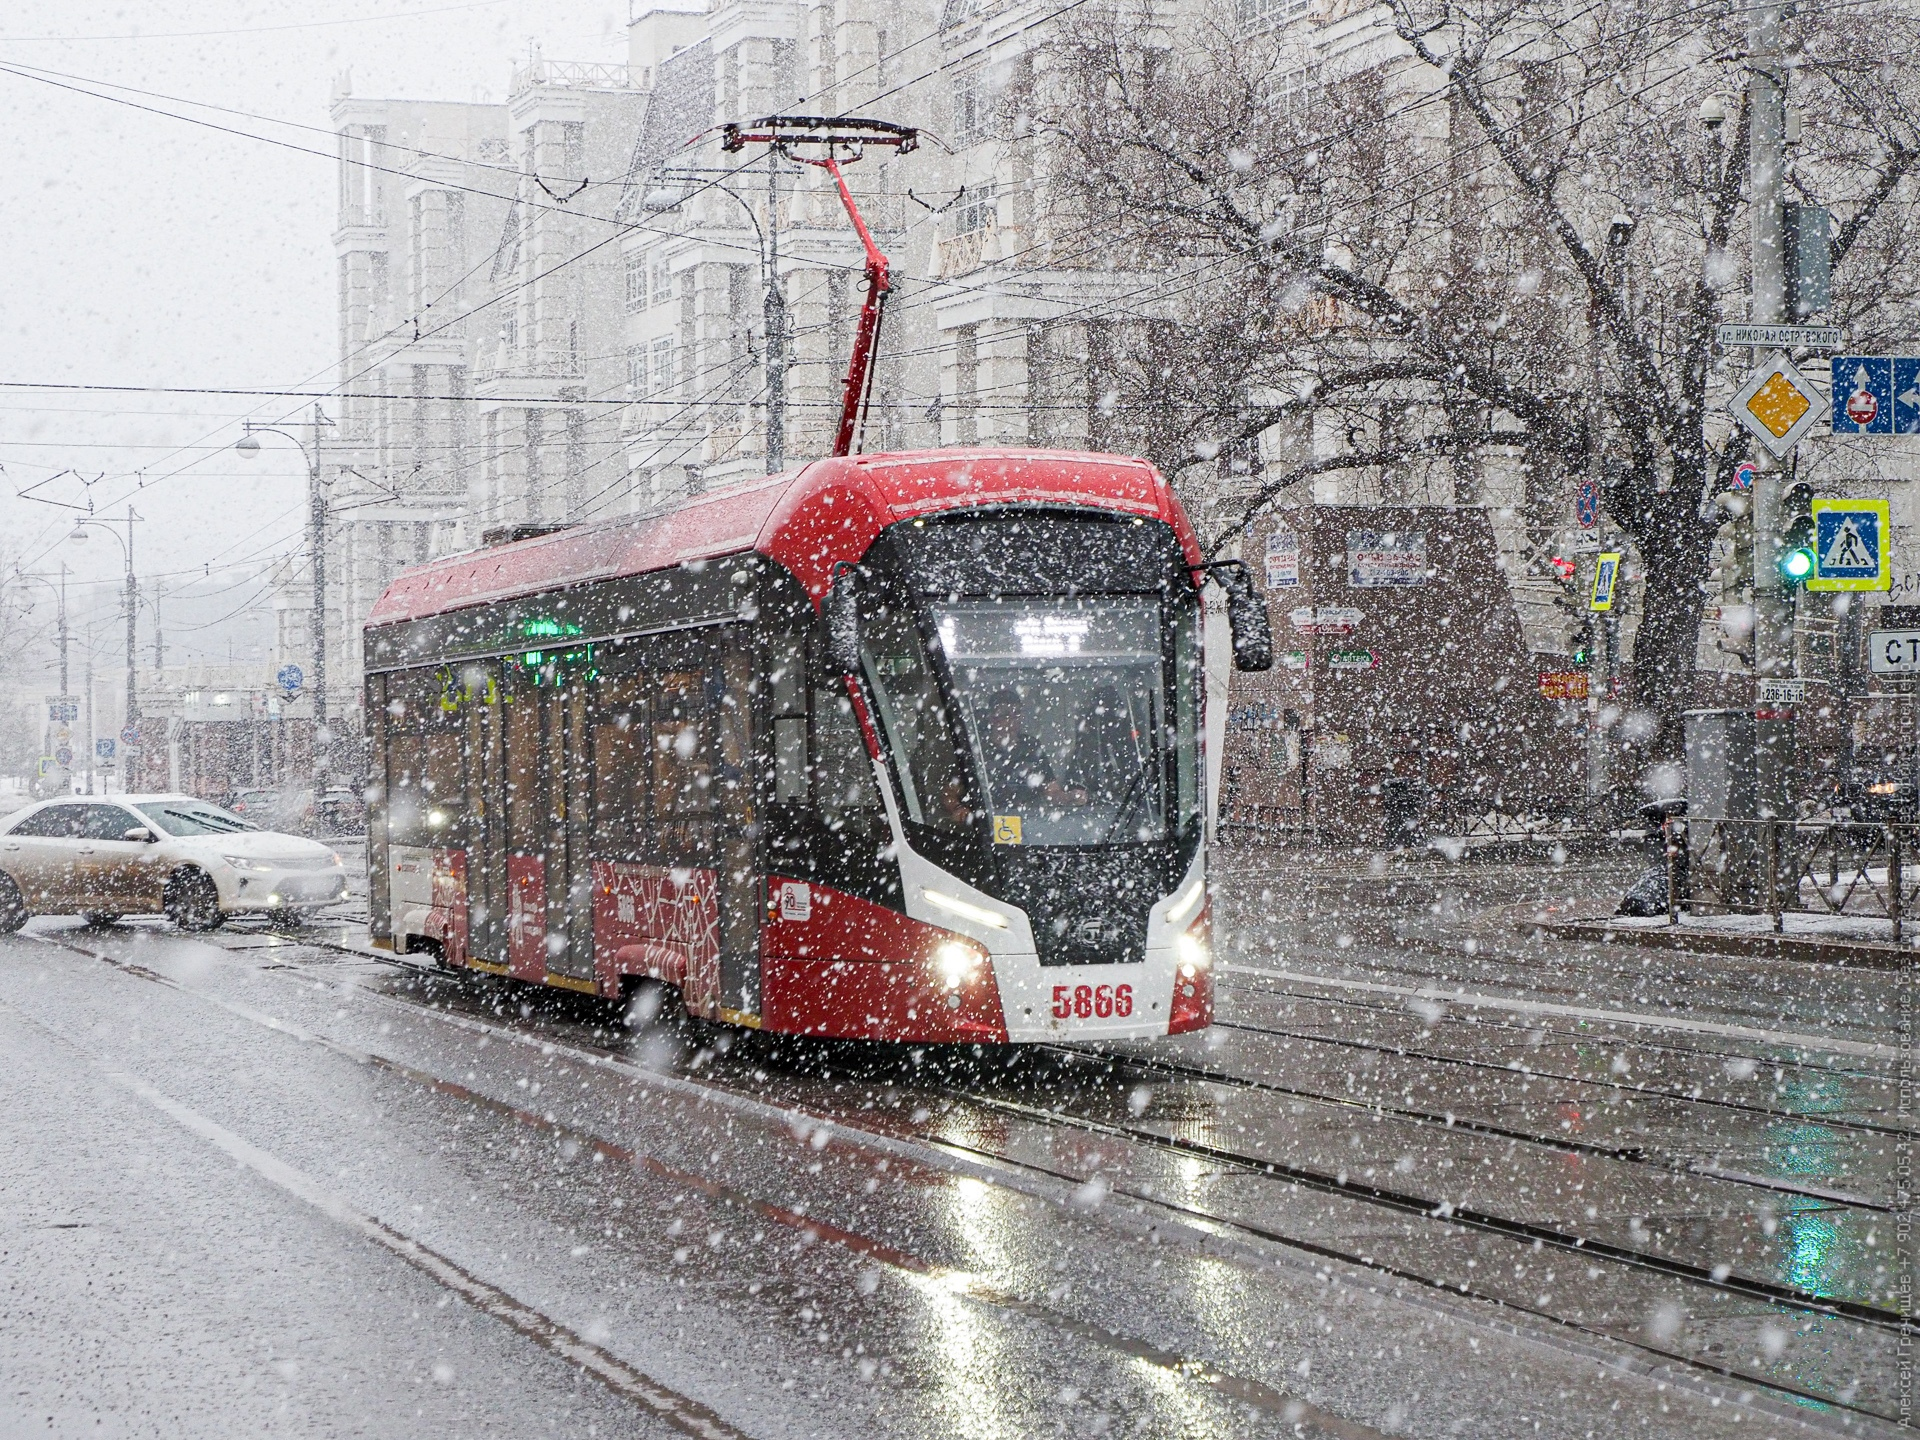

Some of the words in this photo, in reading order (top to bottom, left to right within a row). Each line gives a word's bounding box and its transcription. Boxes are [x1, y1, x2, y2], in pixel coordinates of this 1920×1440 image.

[1722, 331, 1734, 343] ул.
[1736, 329, 1776, 342] НИКОЛАЯ
[1779, 330, 1838, 344] ОСТРВСКОГО
[1051, 983, 1133, 1019] 5866
